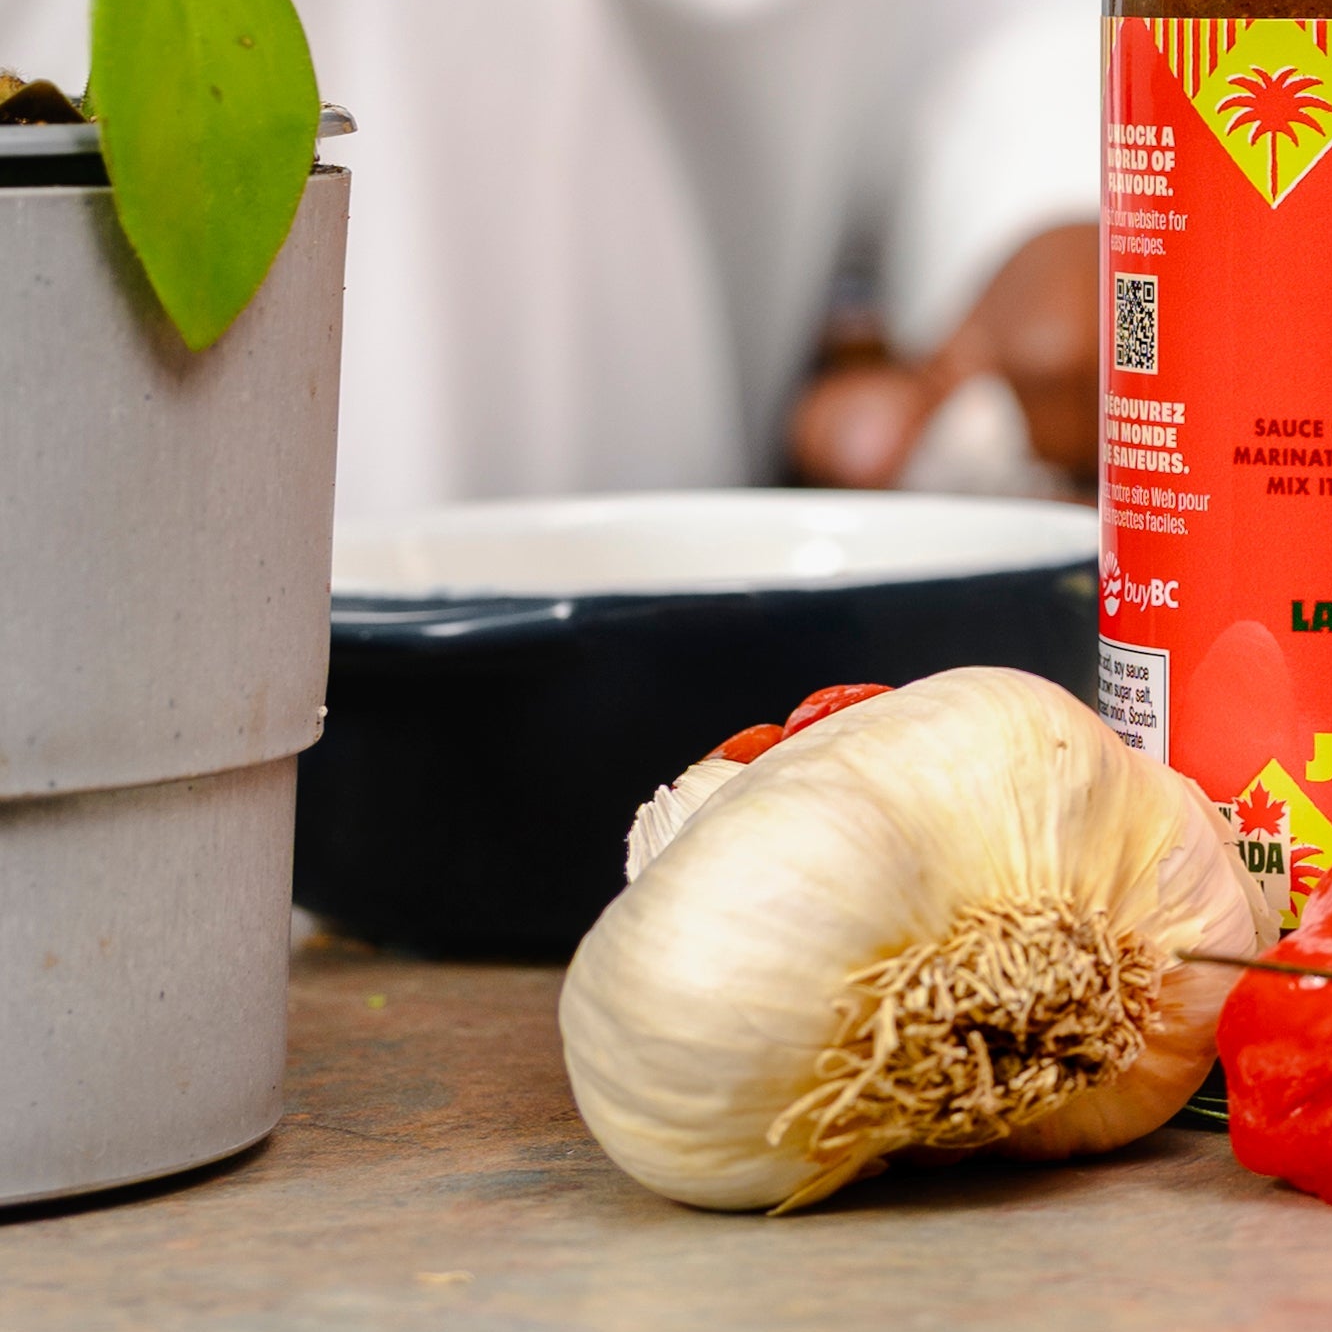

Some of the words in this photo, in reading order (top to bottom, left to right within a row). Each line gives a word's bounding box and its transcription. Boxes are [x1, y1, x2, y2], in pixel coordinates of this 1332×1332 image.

[1107, 123, 1158, 146] UNLOCK
[1161, 126, 1176, 147] A
[1107, 147, 1149, 171] WORLD
[1151, 150, 1176, 172] OF
[1108, 172, 1174, 196] FLAVOUR.
[1127, 208, 1167, 231] website
[1168, 209, 1188, 231] for
[1127, 234, 1167, 257] recipes.
[1120, 421, 1178, 449] MONDE
[1254, 418, 1324, 438] SAUCE
[1113, 446, 1190, 474] SAVEURS.
[1266, 476, 1311, 496] MIX
[1131, 485, 1151, 507] site
[1151, 486, 1177, 510] Web
[1177, 491, 1211, 512] pour
[1145, 510, 1189, 535] faciles.
[1124, 572, 1179, 612] buyBC
[1126, 663, 1149, 681] sauce
[1114, 682, 1135, 703] sugar,
[1128, 706, 1157, 729] Scotch
